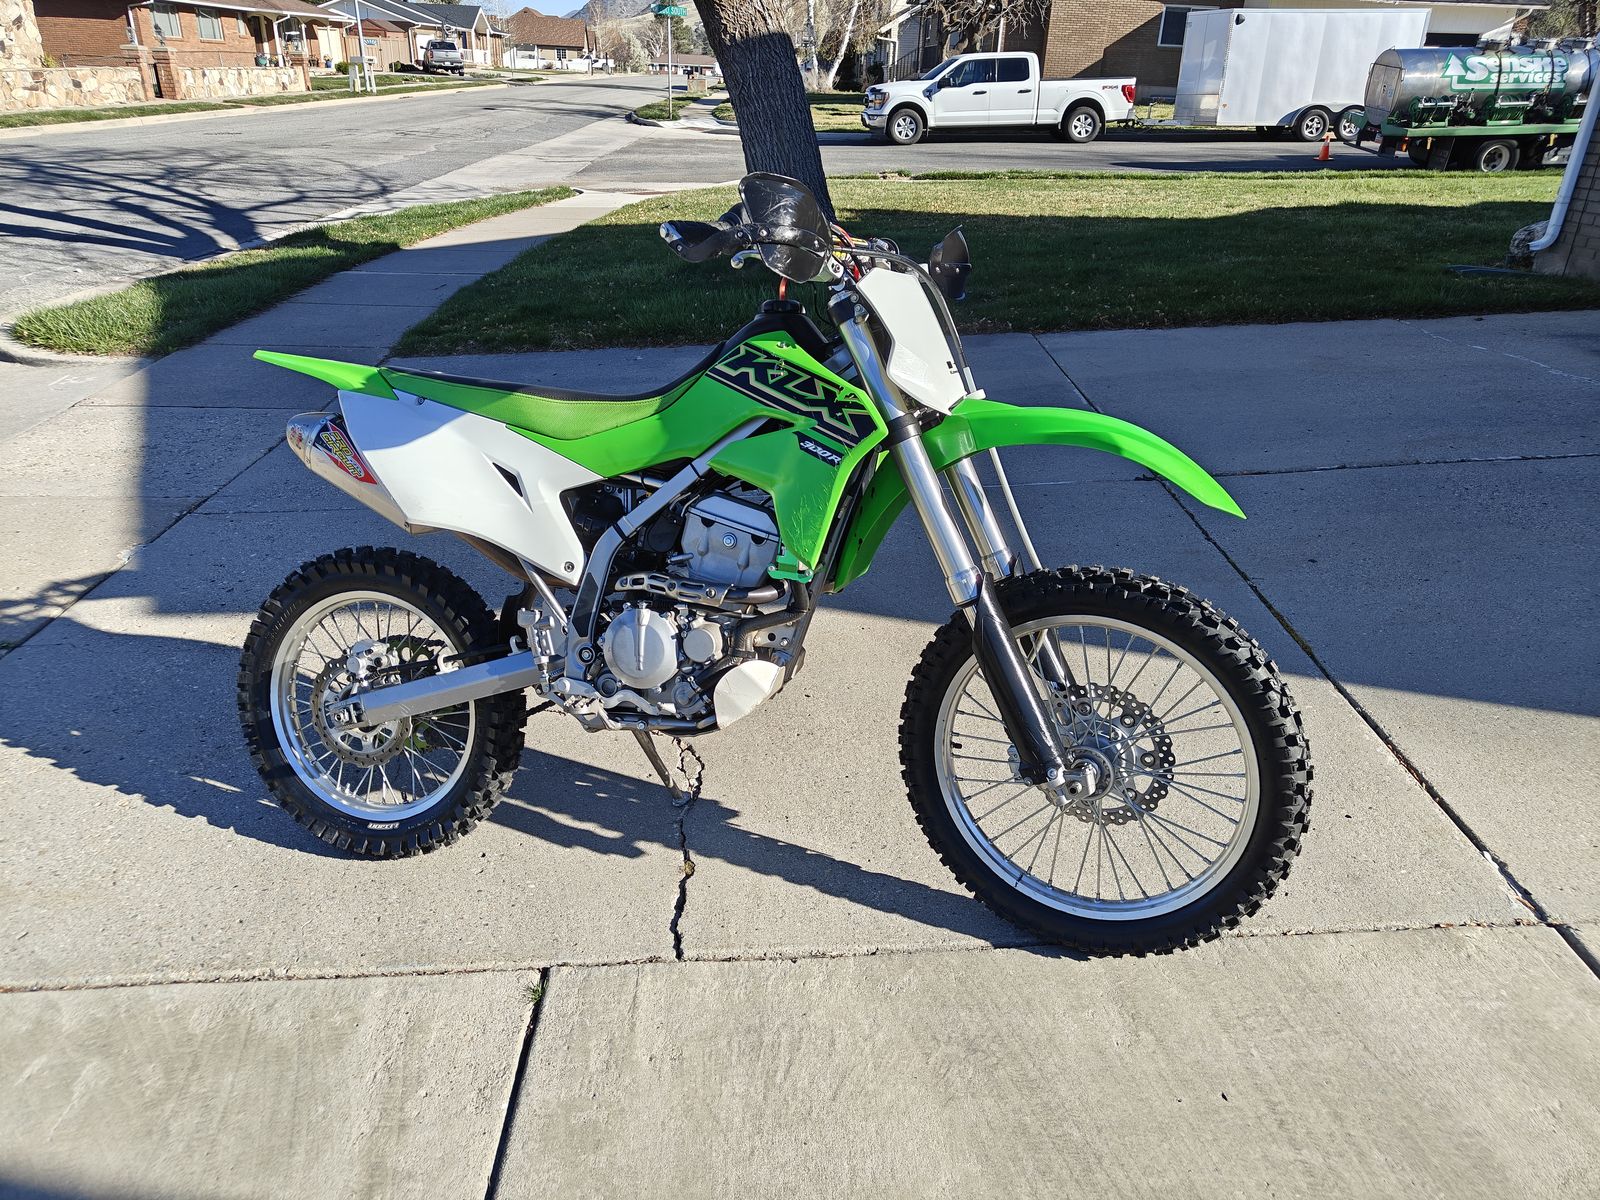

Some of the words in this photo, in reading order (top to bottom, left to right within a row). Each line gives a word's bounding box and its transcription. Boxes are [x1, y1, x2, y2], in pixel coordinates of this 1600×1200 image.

[670, 6, 688, 16] SOUTH
[714, 343, 870, 437] KLX
[321, 434, 363, 477] CIRCUIT
[331, 431, 353, 456] PRO
[800, 440, 842, 464] 300R
